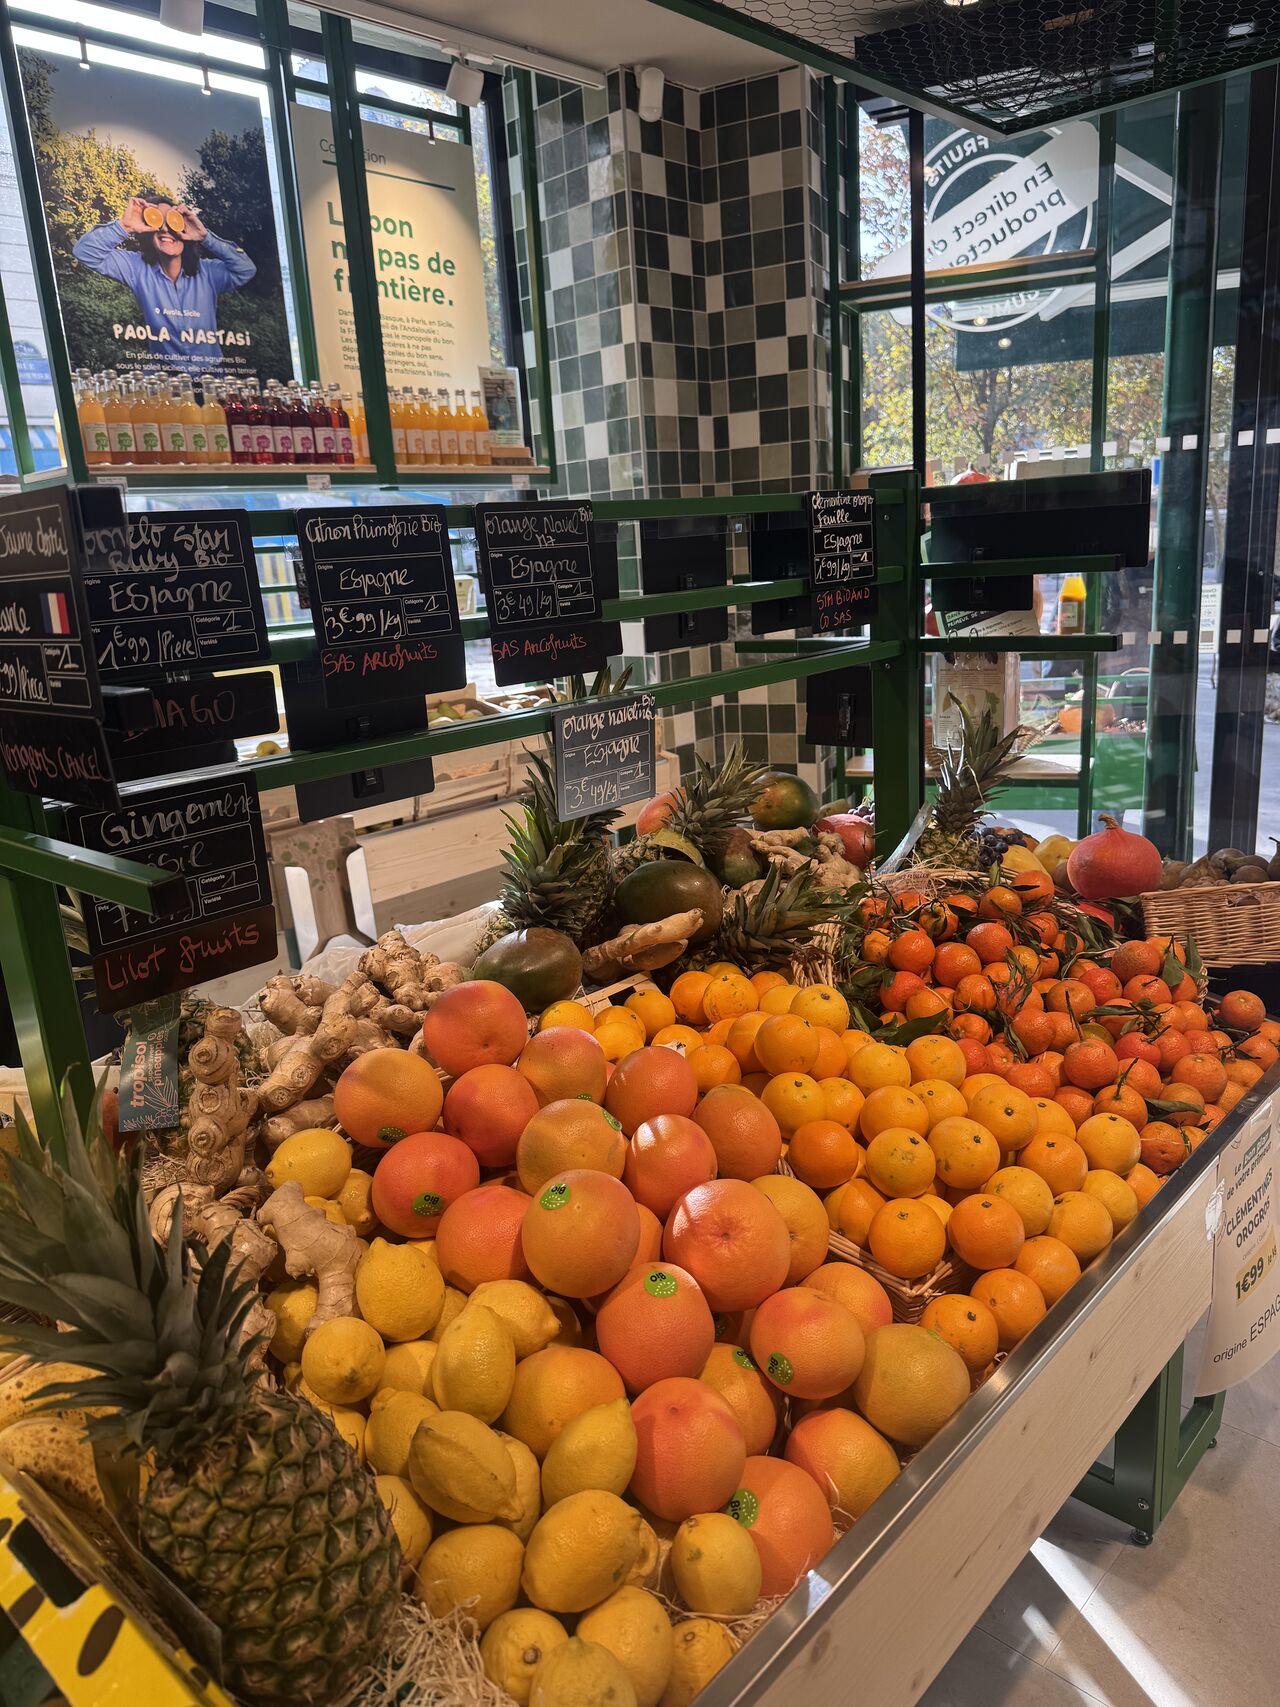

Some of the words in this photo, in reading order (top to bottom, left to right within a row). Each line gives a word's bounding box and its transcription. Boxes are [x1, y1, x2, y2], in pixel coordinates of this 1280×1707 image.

[378, 248, 420, 271] pas
[427, 252, 455, 276] de
[334, 268, 453, 306] fntière.
[113, 324, 170, 342] PAOLA
[126, 351, 136, 359] En
[137, 352, 153, 361] plus
[164, 352, 190, 361] cultiver
[205, 356, 234, 364] agrumes
[134, 362, 142, 370] le
[143, 363, 161, 371] soleil
[201, 365, 223, 373] cultive
[306, 518, 351, 543] Citron
[421, 515, 442, 533] Bio
[194, 551, 234, 566] Bio
[424, 596, 440, 612] 1
[222, 610, 243, 632] 1
[493, 640, 519, 661] SAS
[324, 654, 355, 677] SAS
[201, 874, 225, 884] Catégorie
[154, 1030, 164, 1087] pineapples
[130, 1041, 147, 1108] tropisol
[1234, 1163, 1242, 1176] Le
[551, 1183, 566, 1195] Bio
[1227, 1187, 1235, 1200] de
[1235, 1168, 1250, 1189] votre
[424, 1195, 440, 1204] Bio
[1226, 1167, 1273, 1236] CLÉMENTINES
[1236, 1195, 1270, 1248] OROGROS
[650, 1272, 667, 1282] Bio
[1235, 1257, 1264, 1300] 1€99
[1213, 1337, 1248, 1364] origine
[767, 1357, 778, 1375] Bio
[730, 1500, 741, 1521] Bio
